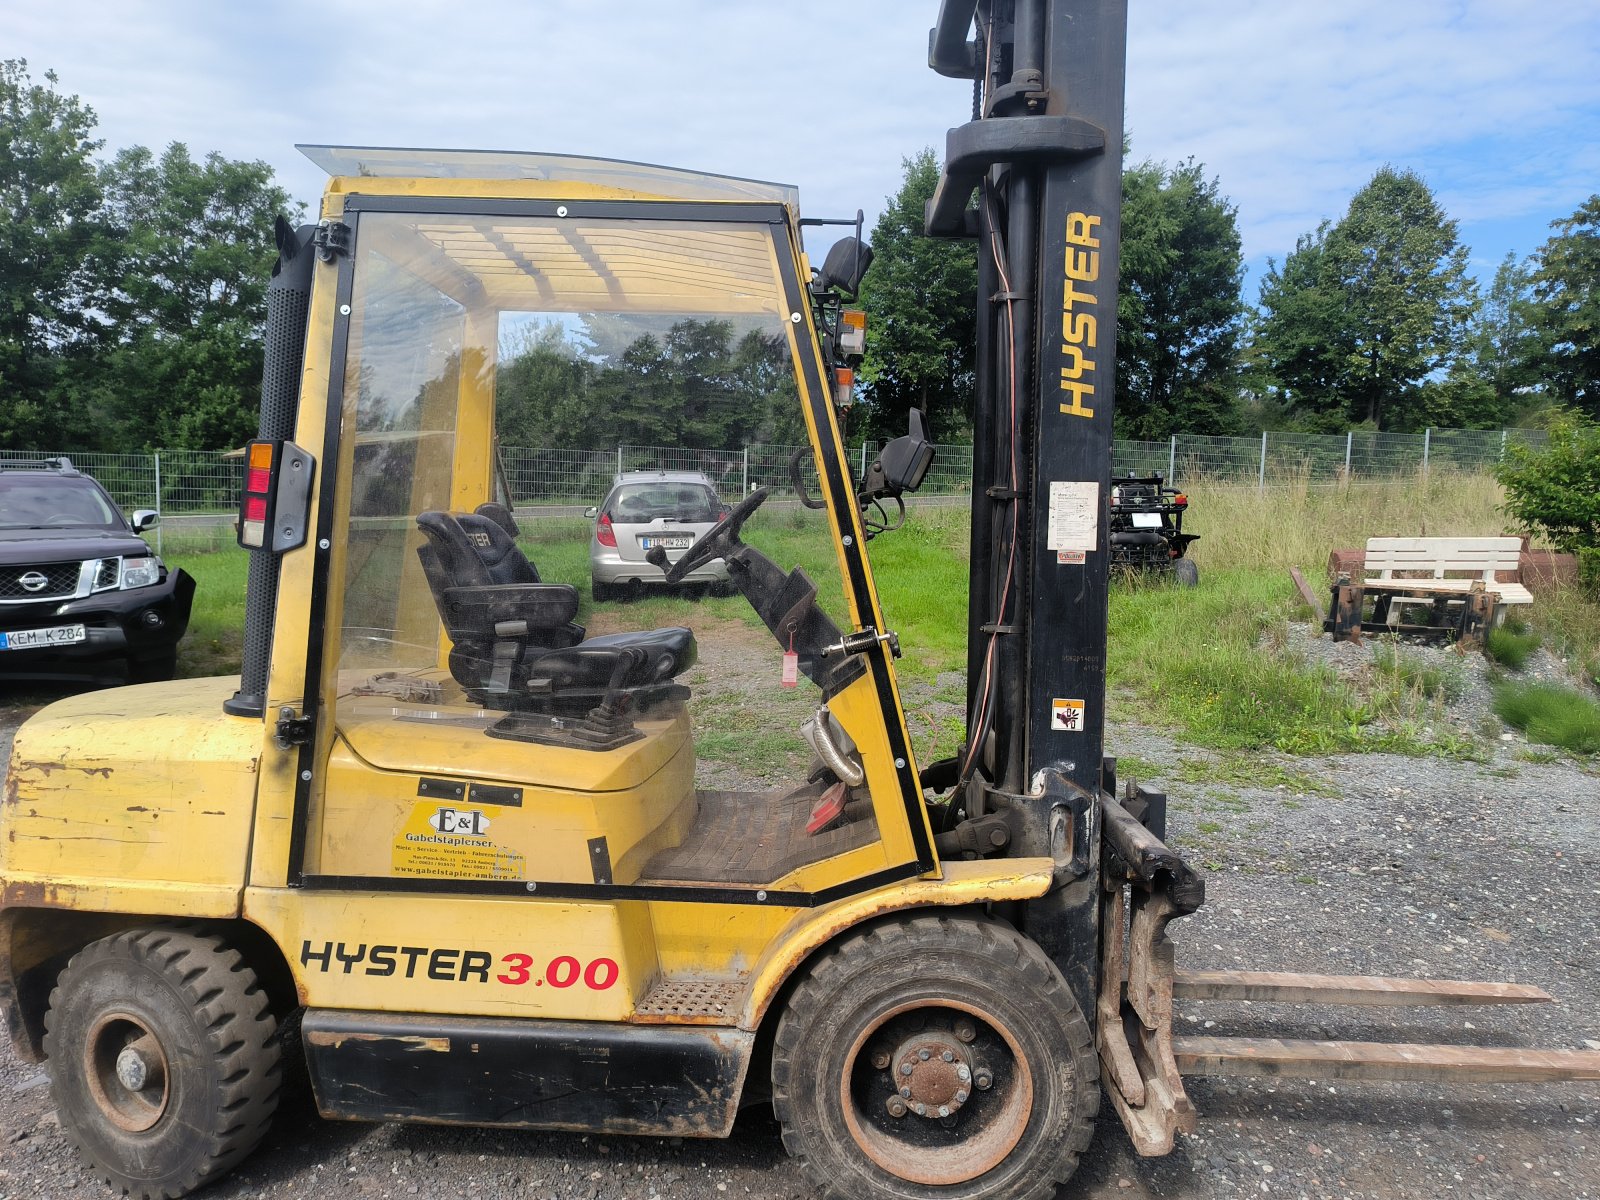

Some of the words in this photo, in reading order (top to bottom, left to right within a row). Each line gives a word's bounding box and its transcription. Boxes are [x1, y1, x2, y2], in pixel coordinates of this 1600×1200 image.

[1059, 211, 1101, 418] HYSTER
[675, 538, 688, 547] 232
[7, 631, 37, 646] KEM
[45, 629, 56, 642] K
[58, 627, 83, 640] 284
[300, 940, 492, 983] HYSTER
[497, 952, 619, 991] 3.00
